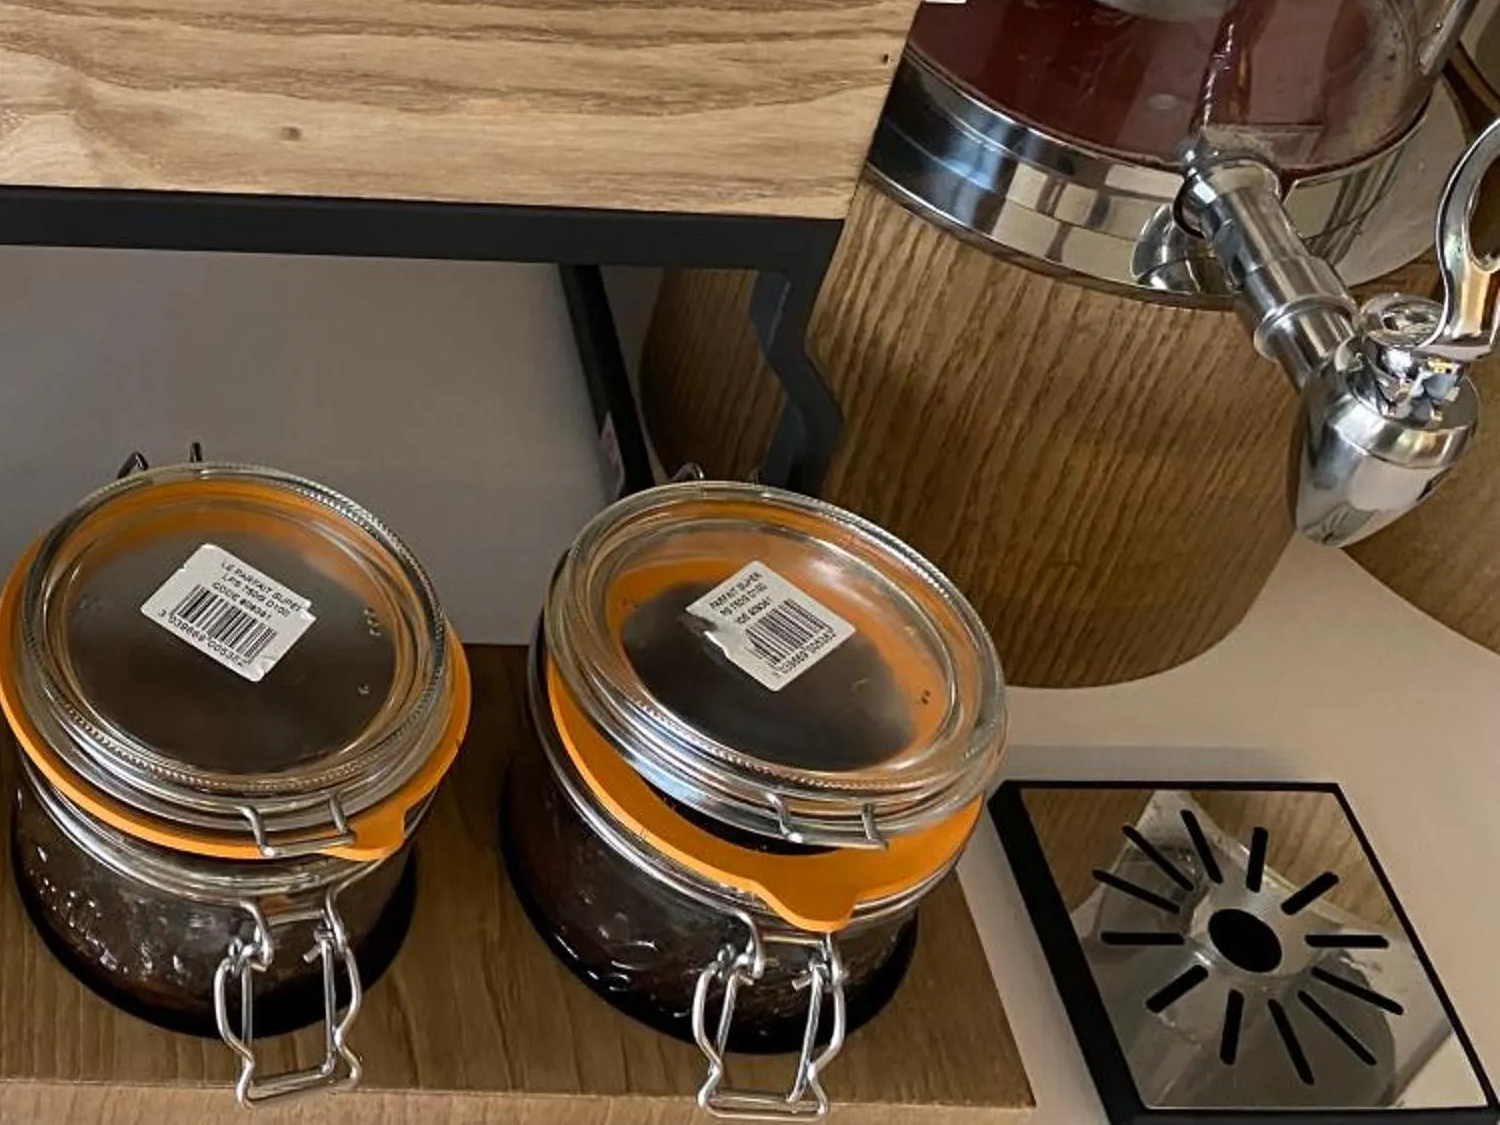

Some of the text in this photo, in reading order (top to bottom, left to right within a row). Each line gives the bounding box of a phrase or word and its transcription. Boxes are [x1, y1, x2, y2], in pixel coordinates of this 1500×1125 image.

[221, 559, 234, 571] LE
[234, 568, 270, 594] PARFAIT
[212, 580, 238, 602] CODE
